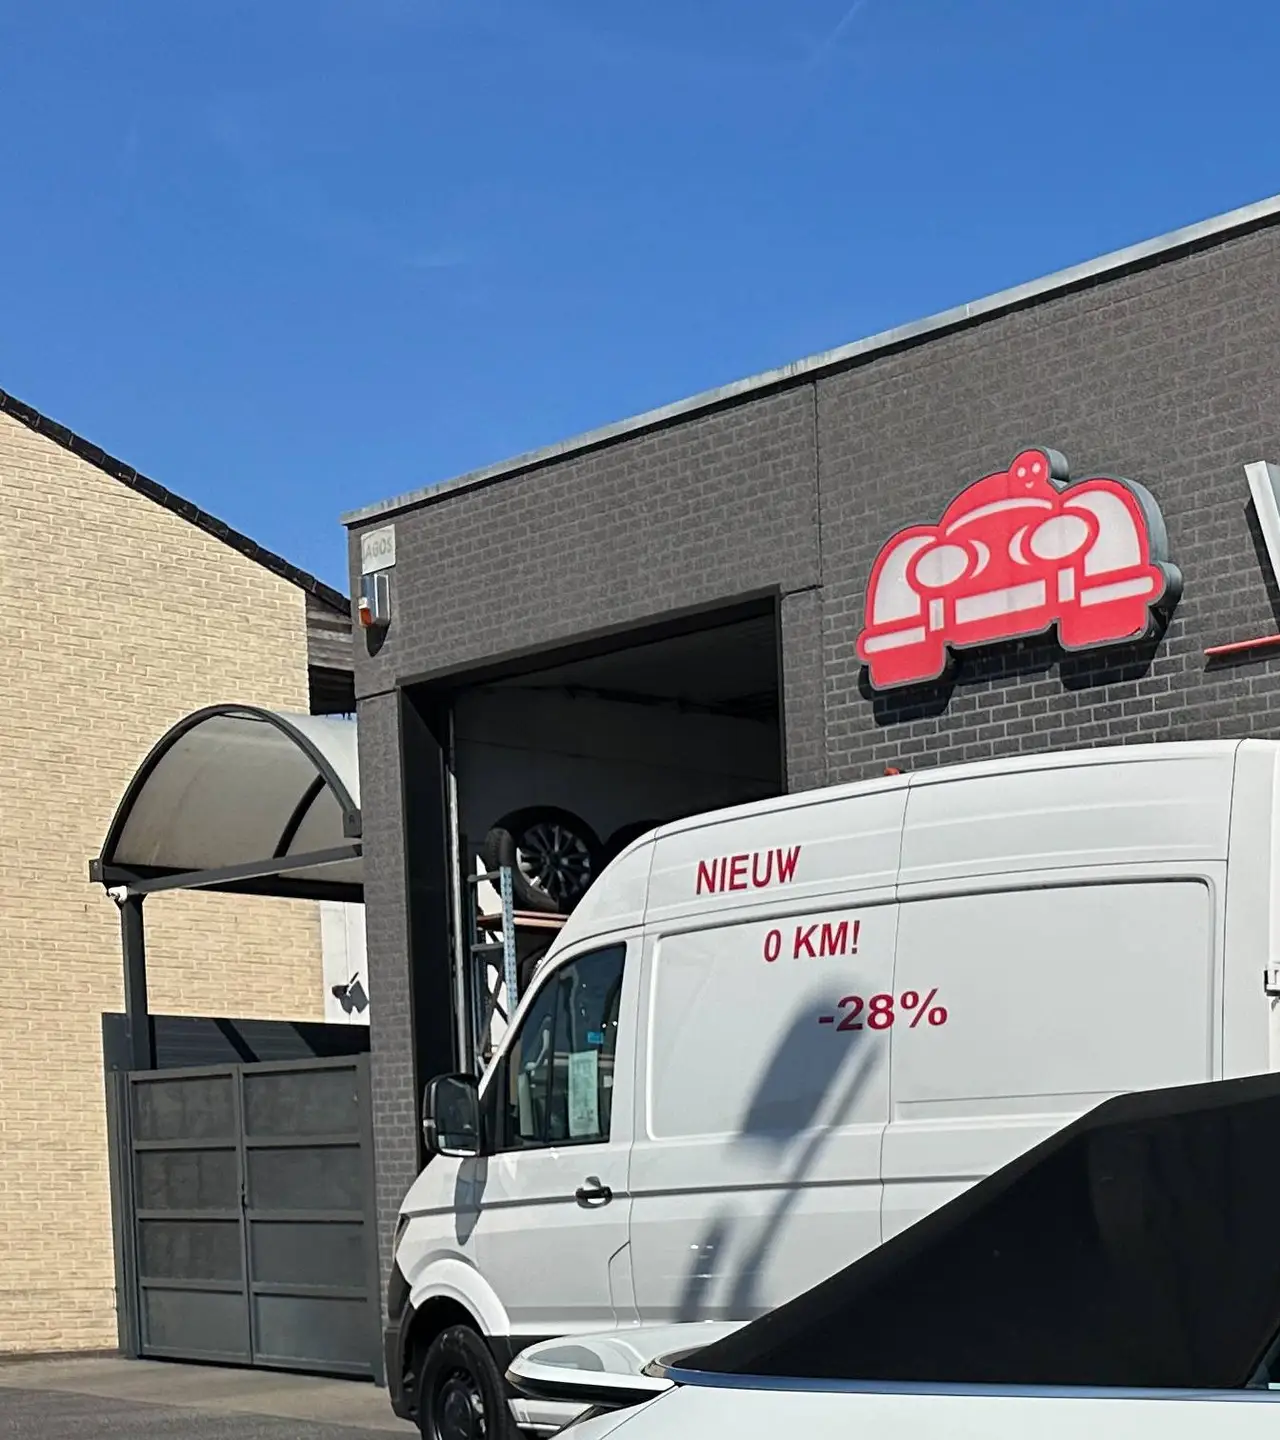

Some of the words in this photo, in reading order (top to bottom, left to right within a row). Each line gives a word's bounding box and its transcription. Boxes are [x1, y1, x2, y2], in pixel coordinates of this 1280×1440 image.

[696, 845, 801, 895] NIEUW
[763, 929, 782, 962] 0
[793, 920, 860, 959] KM!
[818, 988, 948, 1032] -28%
